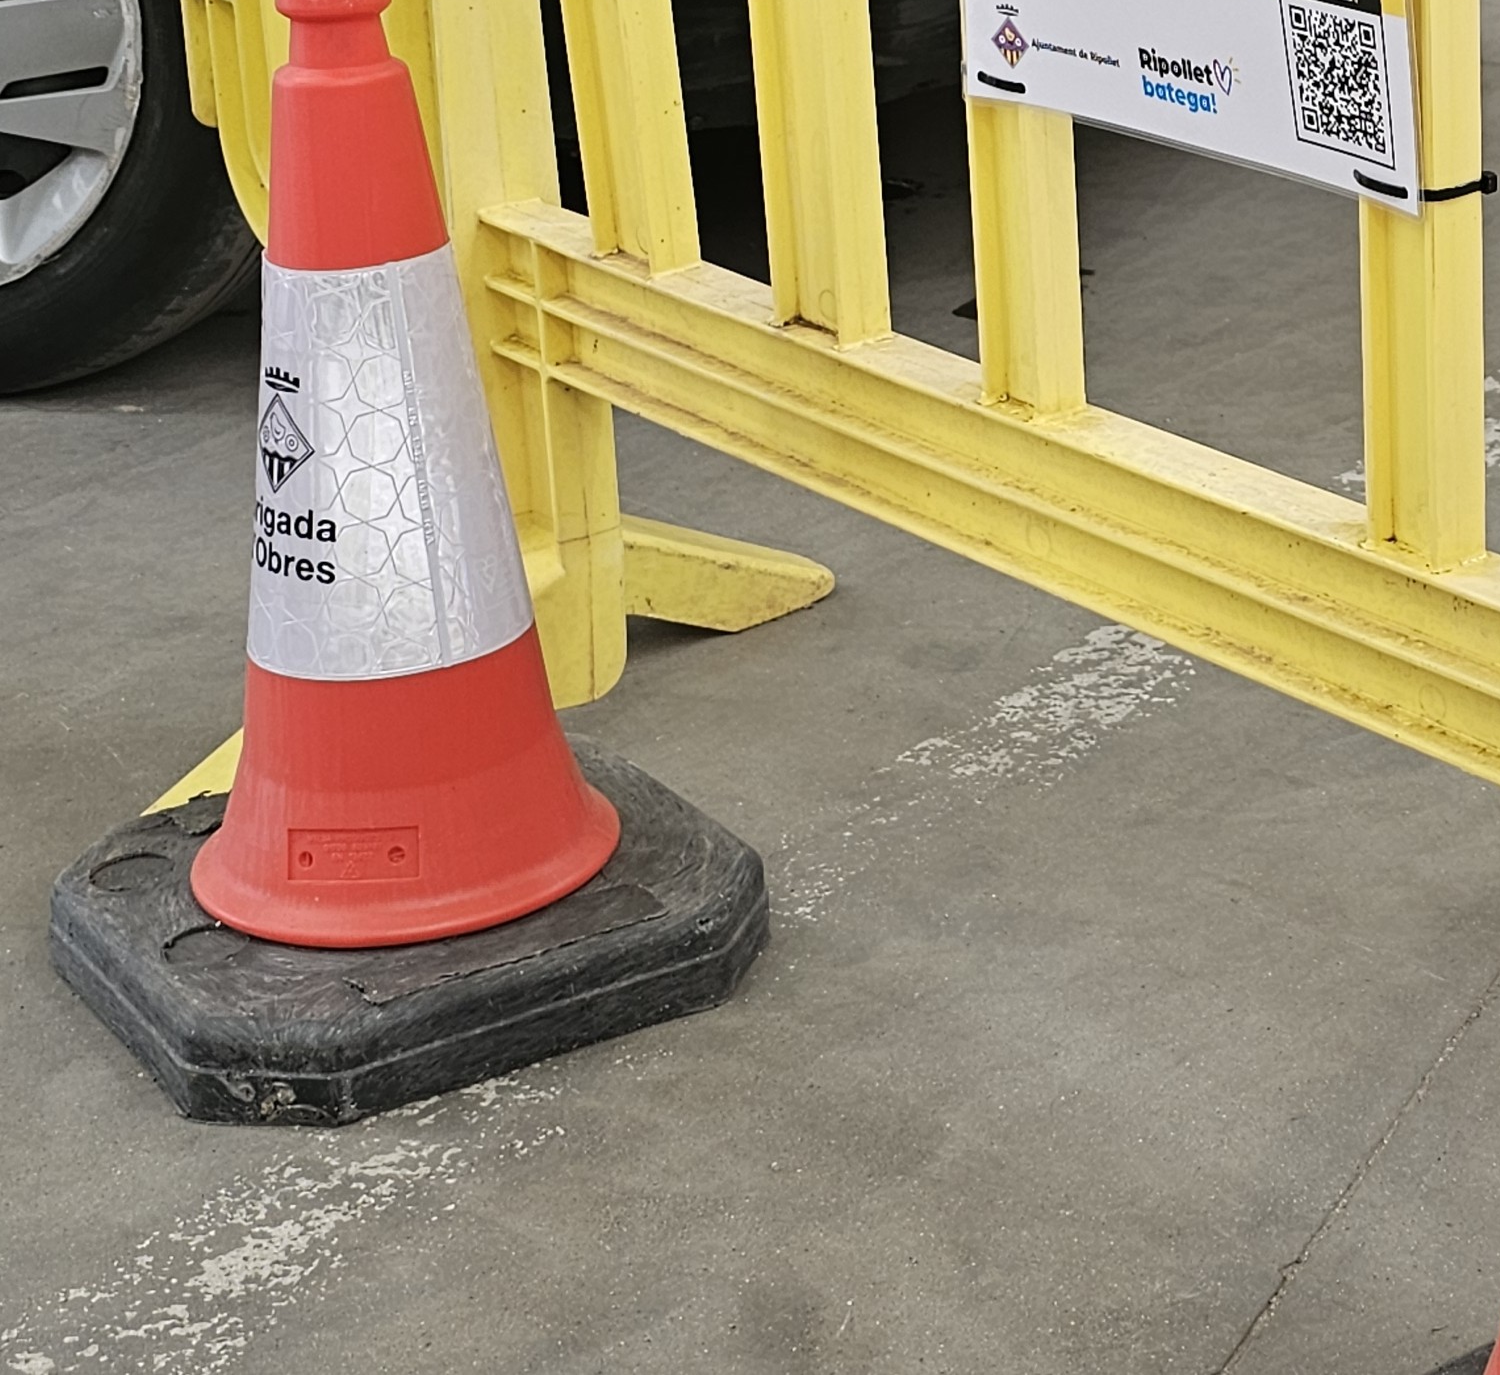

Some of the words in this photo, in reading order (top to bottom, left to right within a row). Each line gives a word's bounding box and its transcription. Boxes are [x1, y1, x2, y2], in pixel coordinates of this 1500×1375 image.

[1031, 38, 1077, 58] Ajuntament
[1078, 49, 1088, 60] de
[1090, 51, 1120, 68] Ripollet
[1138, 47, 1213, 86] Ripollet
[1141, 75, 1218, 114] batega!
[255, 495, 336, 543] rigada
[252, 533, 335, 584] Obres
